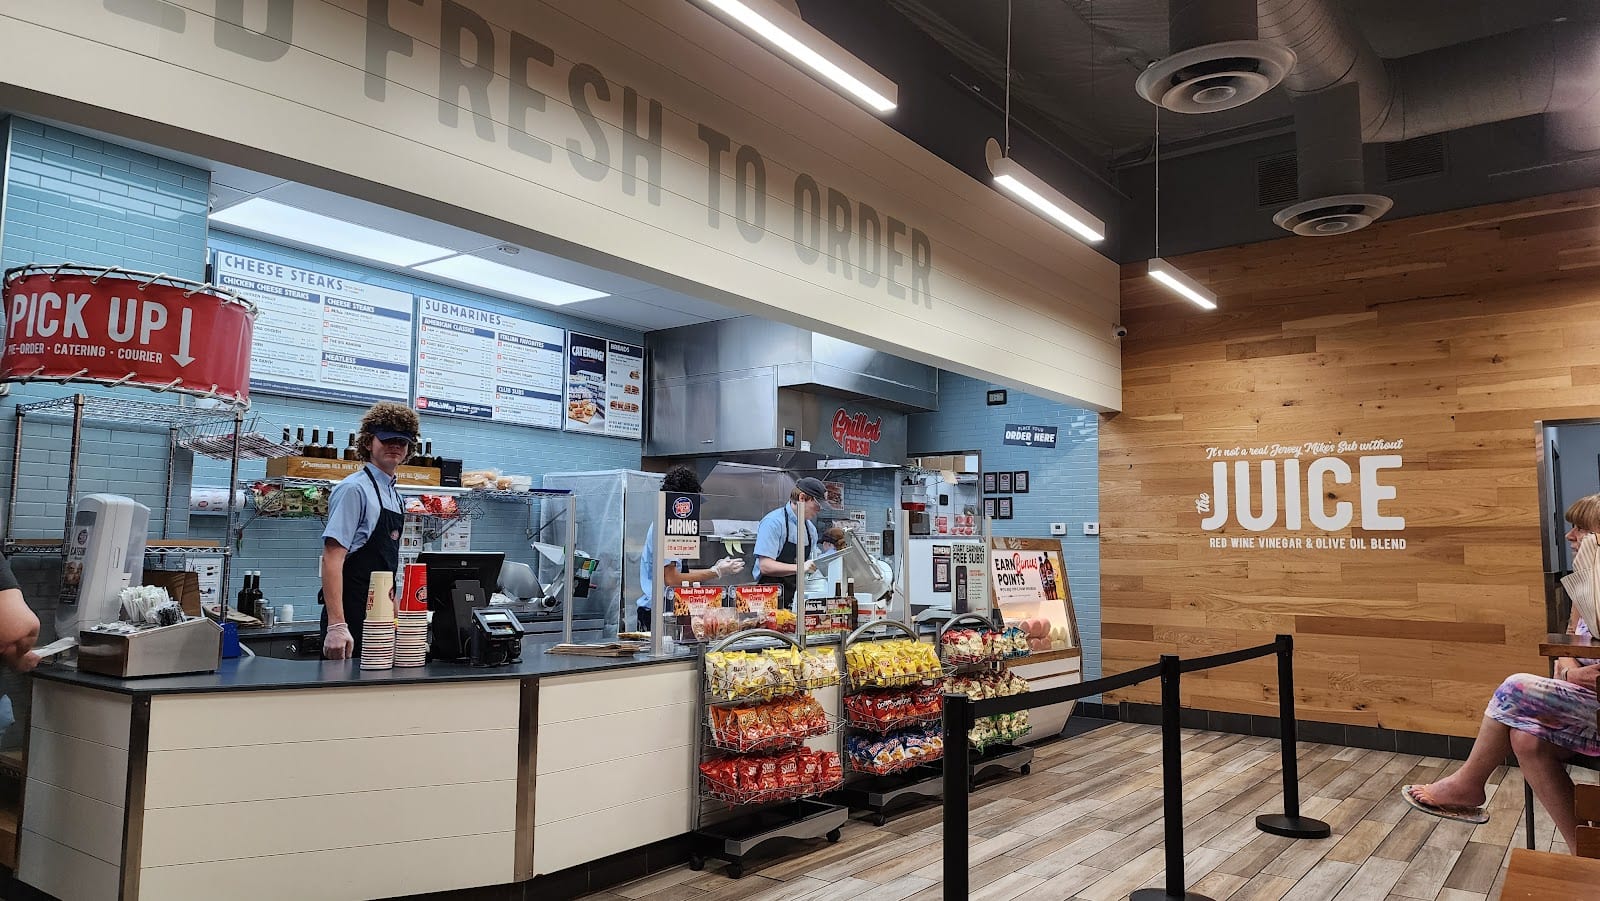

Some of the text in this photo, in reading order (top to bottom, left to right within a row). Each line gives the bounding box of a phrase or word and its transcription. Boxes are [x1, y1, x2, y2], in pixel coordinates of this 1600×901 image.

[697, 123, 767, 243] TO
[794, 173, 933, 310] ORDER
[225, 255, 284, 279] CHEESE
[291, 270, 344, 291] STEAKS
[223, 276, 255, 289] CHICKEN
[256, 281, 285, 294] CHEESE
[284, 288, 310, 300] STEAKS
[328, 298, 376, 313] CHEESE STEAKS
[425, 300, 502, 325] SUBMARINES
[8, 292, 168, 346] PICK UP
[424, 318, 453, 329] AMERICAN
[453, 324, 475, 334] CLASSICS
[519, 338, 545, 349] FAVORITES
[54, 344, 106, 358] CATERING
[117, 348, 163, 364] COURIER
[325, 353, 358, 364] MEATLESS
[571, 345, 605, 362] CATERING!
[832, 408, 882, 448] Grilled
[1005, 430, 1055, 443] ORDER HERE
[1205, 438, 1404, 459] It's not a real Jersey Mike's Sub without
[1201, 455, 1406, 531] JUICE
[1195, 492, 1210, 514] the
[667, 519, 698, 535] HIRING
[1209, 538, 1407, 550] RED WINE VINEGAR & OLIVE OIL BLEND
[952, 552, 967, 564] FREE
[995, 558, 1016, 571] EARN
[997, 573, 1025, 586] POINTS
[762, 763, 776, 774] Sun
[781, 761, 798, 774] Sun
